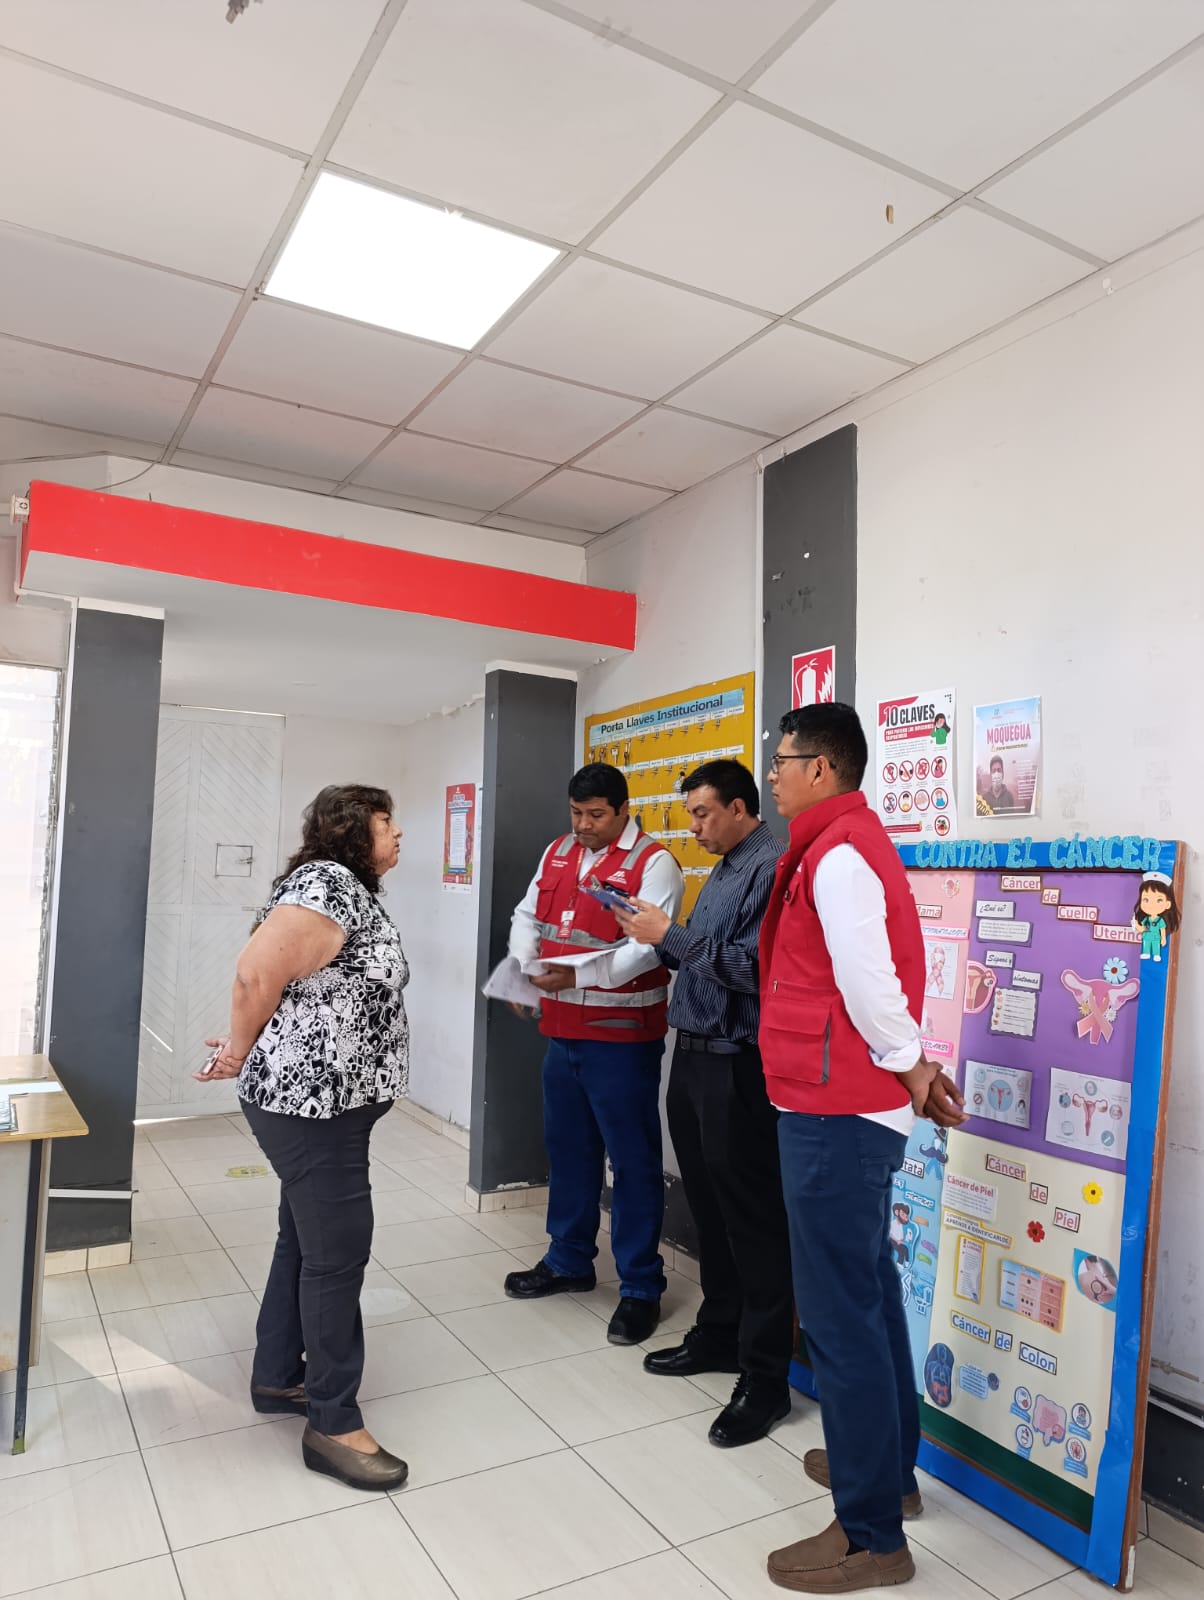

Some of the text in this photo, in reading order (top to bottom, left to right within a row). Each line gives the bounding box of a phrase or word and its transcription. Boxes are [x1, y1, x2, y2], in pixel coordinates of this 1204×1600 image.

[601, 721, 624, 734] Porta
[626, 714, 655, 729] Llaves
[657, 695, 723, 721] Institucional
[884, 704, 935, 727] 10 CLAVES
[986, 723, 1031, 744] MOQUEGUA
[915, 832, 1161, 871] CONTRA EL CÁNCER
[1002, 877, 1041, 889] Cáncer
[1043, 891, 1057, 903] de
[1059, 907, 1097, 920] Cuello
[904, 1161, 923, 1176] tata
[947, 1175, 994, 1198] Cáncer de Piel
[988, 1158, 1078, 1230] Cáncer de Piel
[952, 1314, 1056, 1372] Cáncer de Colon
